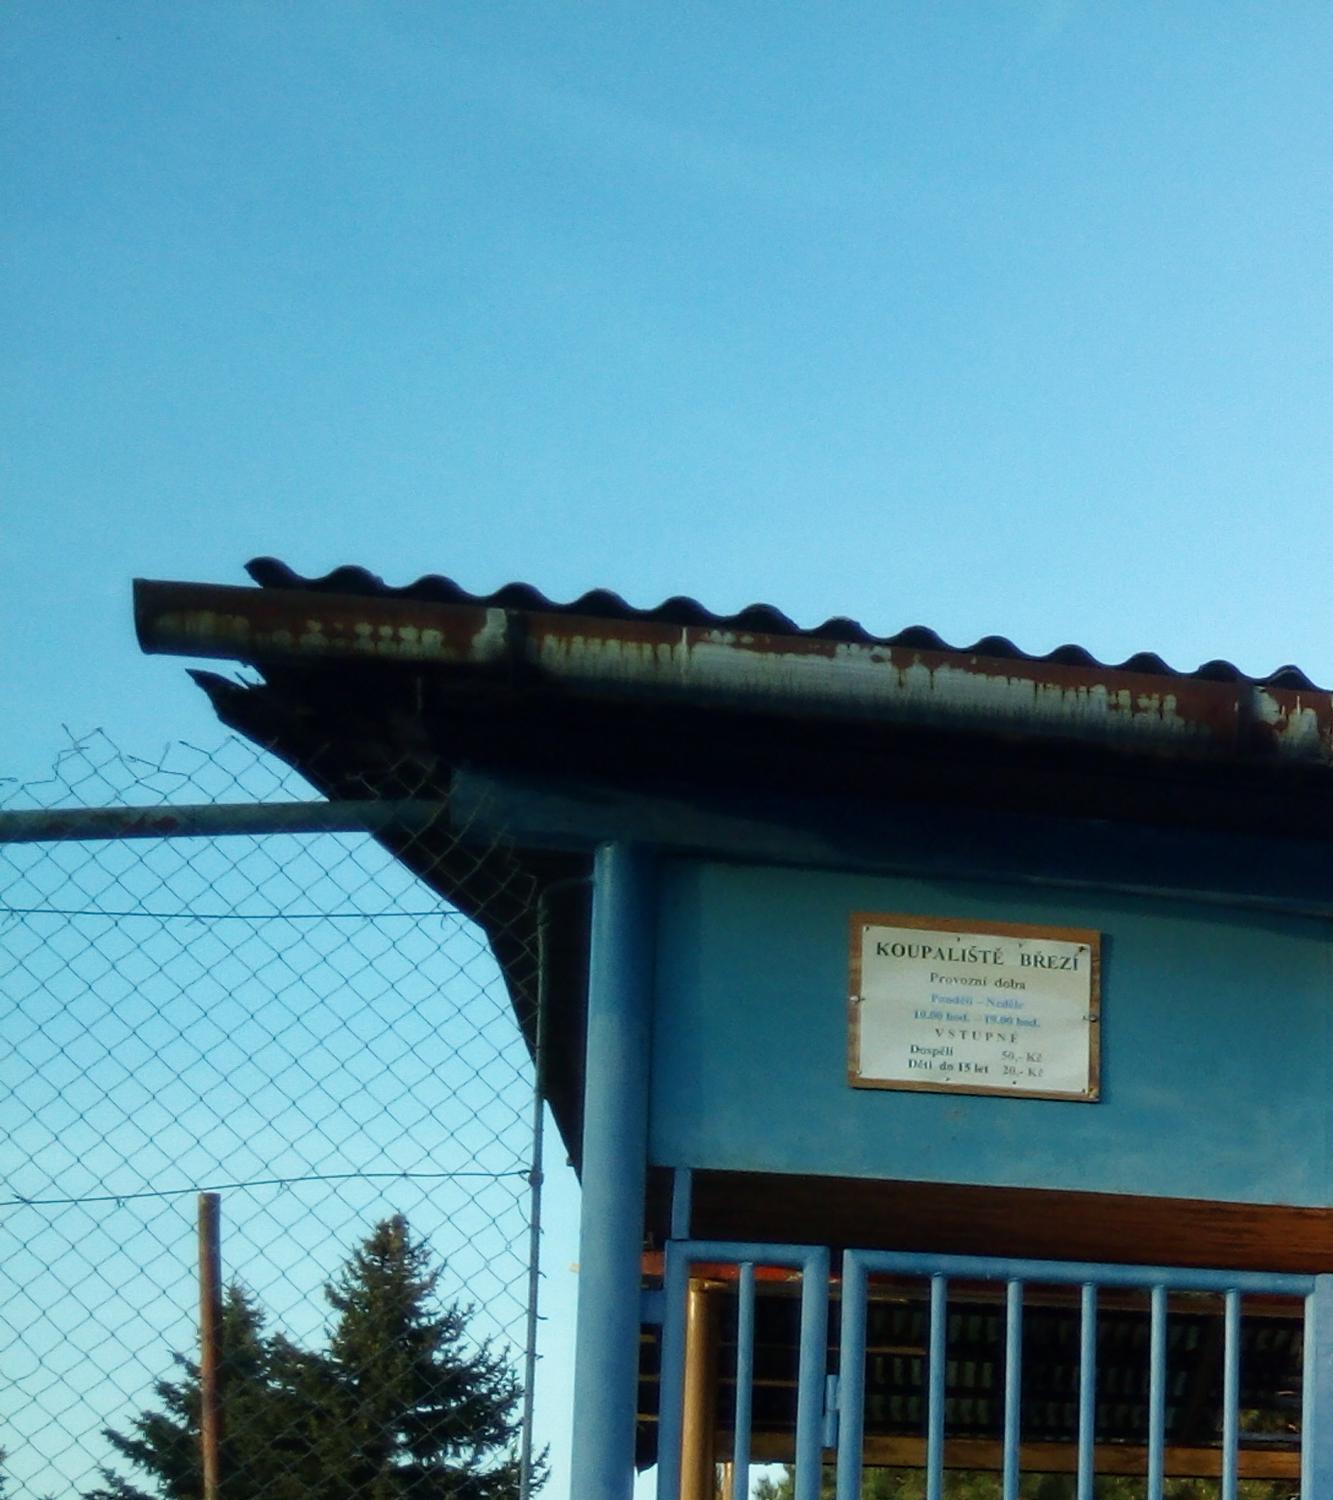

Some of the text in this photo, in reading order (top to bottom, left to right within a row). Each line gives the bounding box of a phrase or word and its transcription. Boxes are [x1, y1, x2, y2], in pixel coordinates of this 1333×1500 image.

[876, 942, 1079, 972] KOUPALIŠTĚ BŘEZÍ
[930, 972, 1026, 990] Provozní doba
[910, 1044, 953, 1058] Dospělí
[1026, 1051, 1042, 1063] Kč
[908, 1058, 932, 1070] Děti
[940, 1060, 954, 1072] do
[958, 1062, 971, 1073] 15
[974, 1063, 989, 1074] let
[1027, 1067, 1043, 1078] Kč
